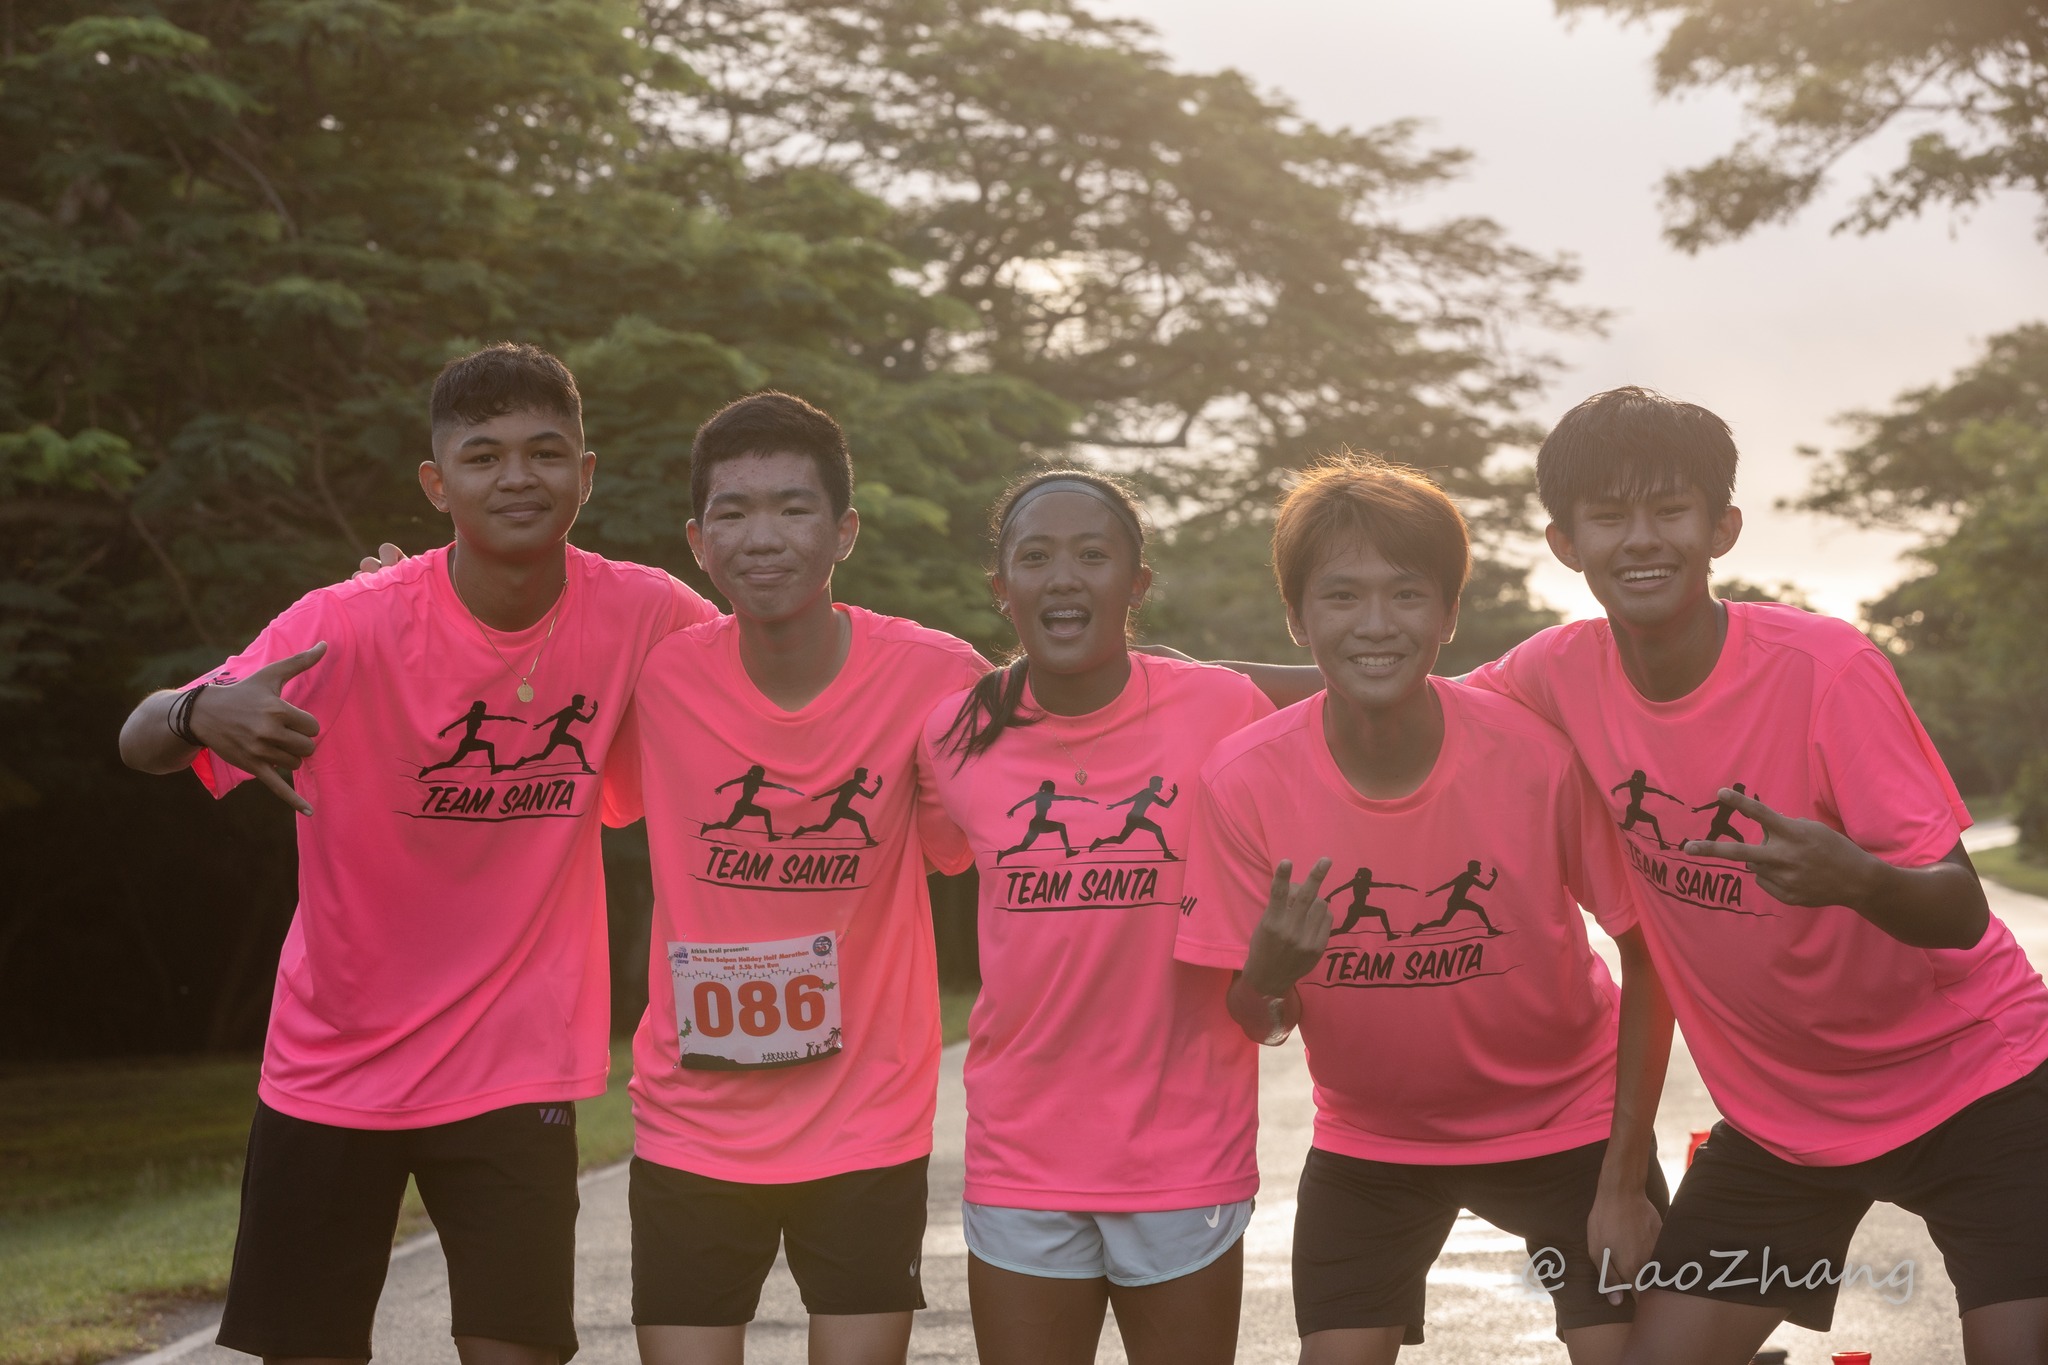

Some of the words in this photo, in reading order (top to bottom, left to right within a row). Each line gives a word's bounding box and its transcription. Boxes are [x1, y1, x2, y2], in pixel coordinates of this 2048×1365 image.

[422, 786, 495, 814] TEAM
[499, 779, 576, 815] SANTA
[706, 846, 774, 882] TEAM
[779, 854, 860, 884] SANTA
[1626, 838, 1668, 887] TEAM
[1675, 866, 1742, 907] SANTA
[1007, 870, 1073, 905] TEAM
[1078, 868, 1158, 901] SANTA
[723, 946, 750, 954] presents:
[779, 950, 809, 959] Marathon
[1326, 951, 1396, 982] TEAM
[1403, 943, 1484, 981] SANTA
[693, 974, 826, 1038] 086
